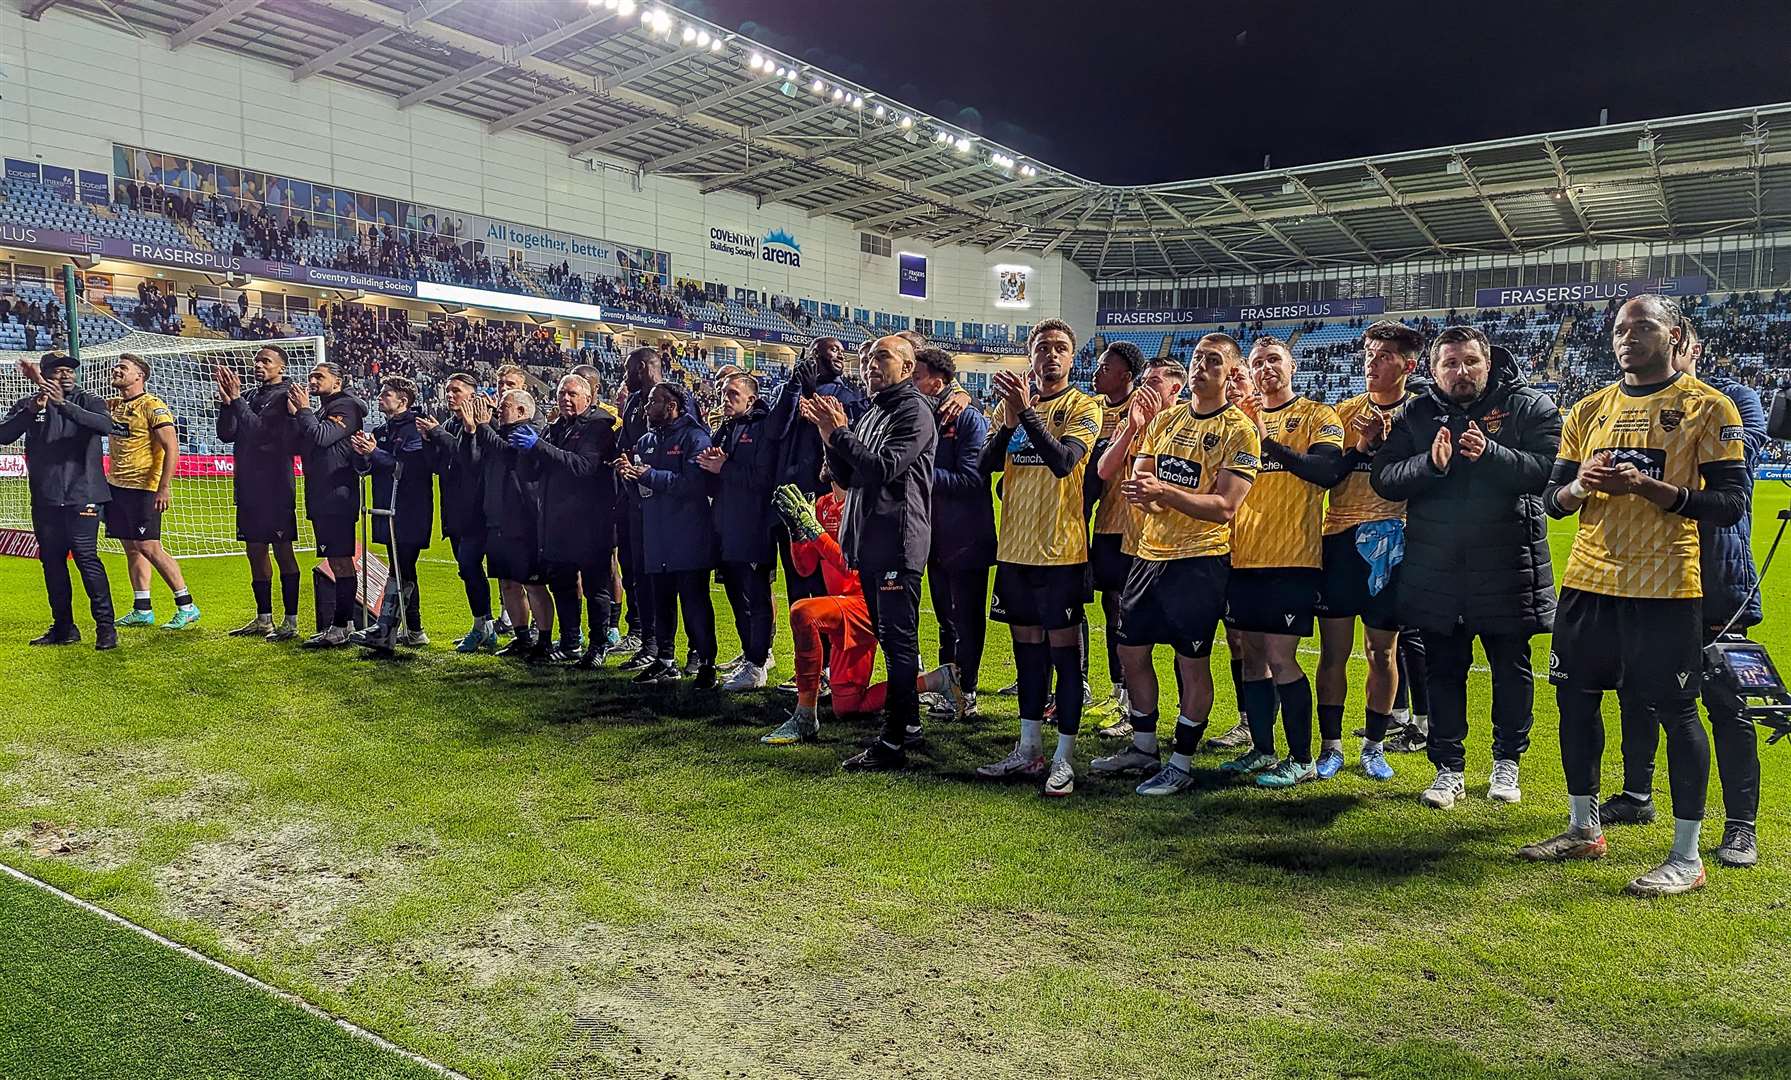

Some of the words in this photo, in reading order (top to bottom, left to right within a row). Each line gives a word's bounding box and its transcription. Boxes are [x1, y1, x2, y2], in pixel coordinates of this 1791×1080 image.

[0, 225, 37, 243] LUS
[487, 224, 506, 240] All
[510, 229, 569, 254] together,
[572, 240, 609, 259] better
[710, 228, 756, 247] COVENTRY
[132, 243, 241, 270] FRASERSPLUS
[710, 241, 734, 255] Building
[735, 246, 756, 260] Society
[762, 246, 801, 268] arena
[310, 269, 349, 285] Coventry
[350, 275, 384, 289] Building
[384, 280, 413, 294] Society
[1500, 283, 1629, 304] FRASERSPLUS
[600, 310, 626, 321] Coventry
[625, 313, 648, 324] Building
[648, 315, 667, 327] Society
[1106, 311, 1193, 324] FRASERSPLUS
[1240, 303, 1331, 320] FRASERSPLUS
[703, 322, 751, 337] FRASERSPLUS
